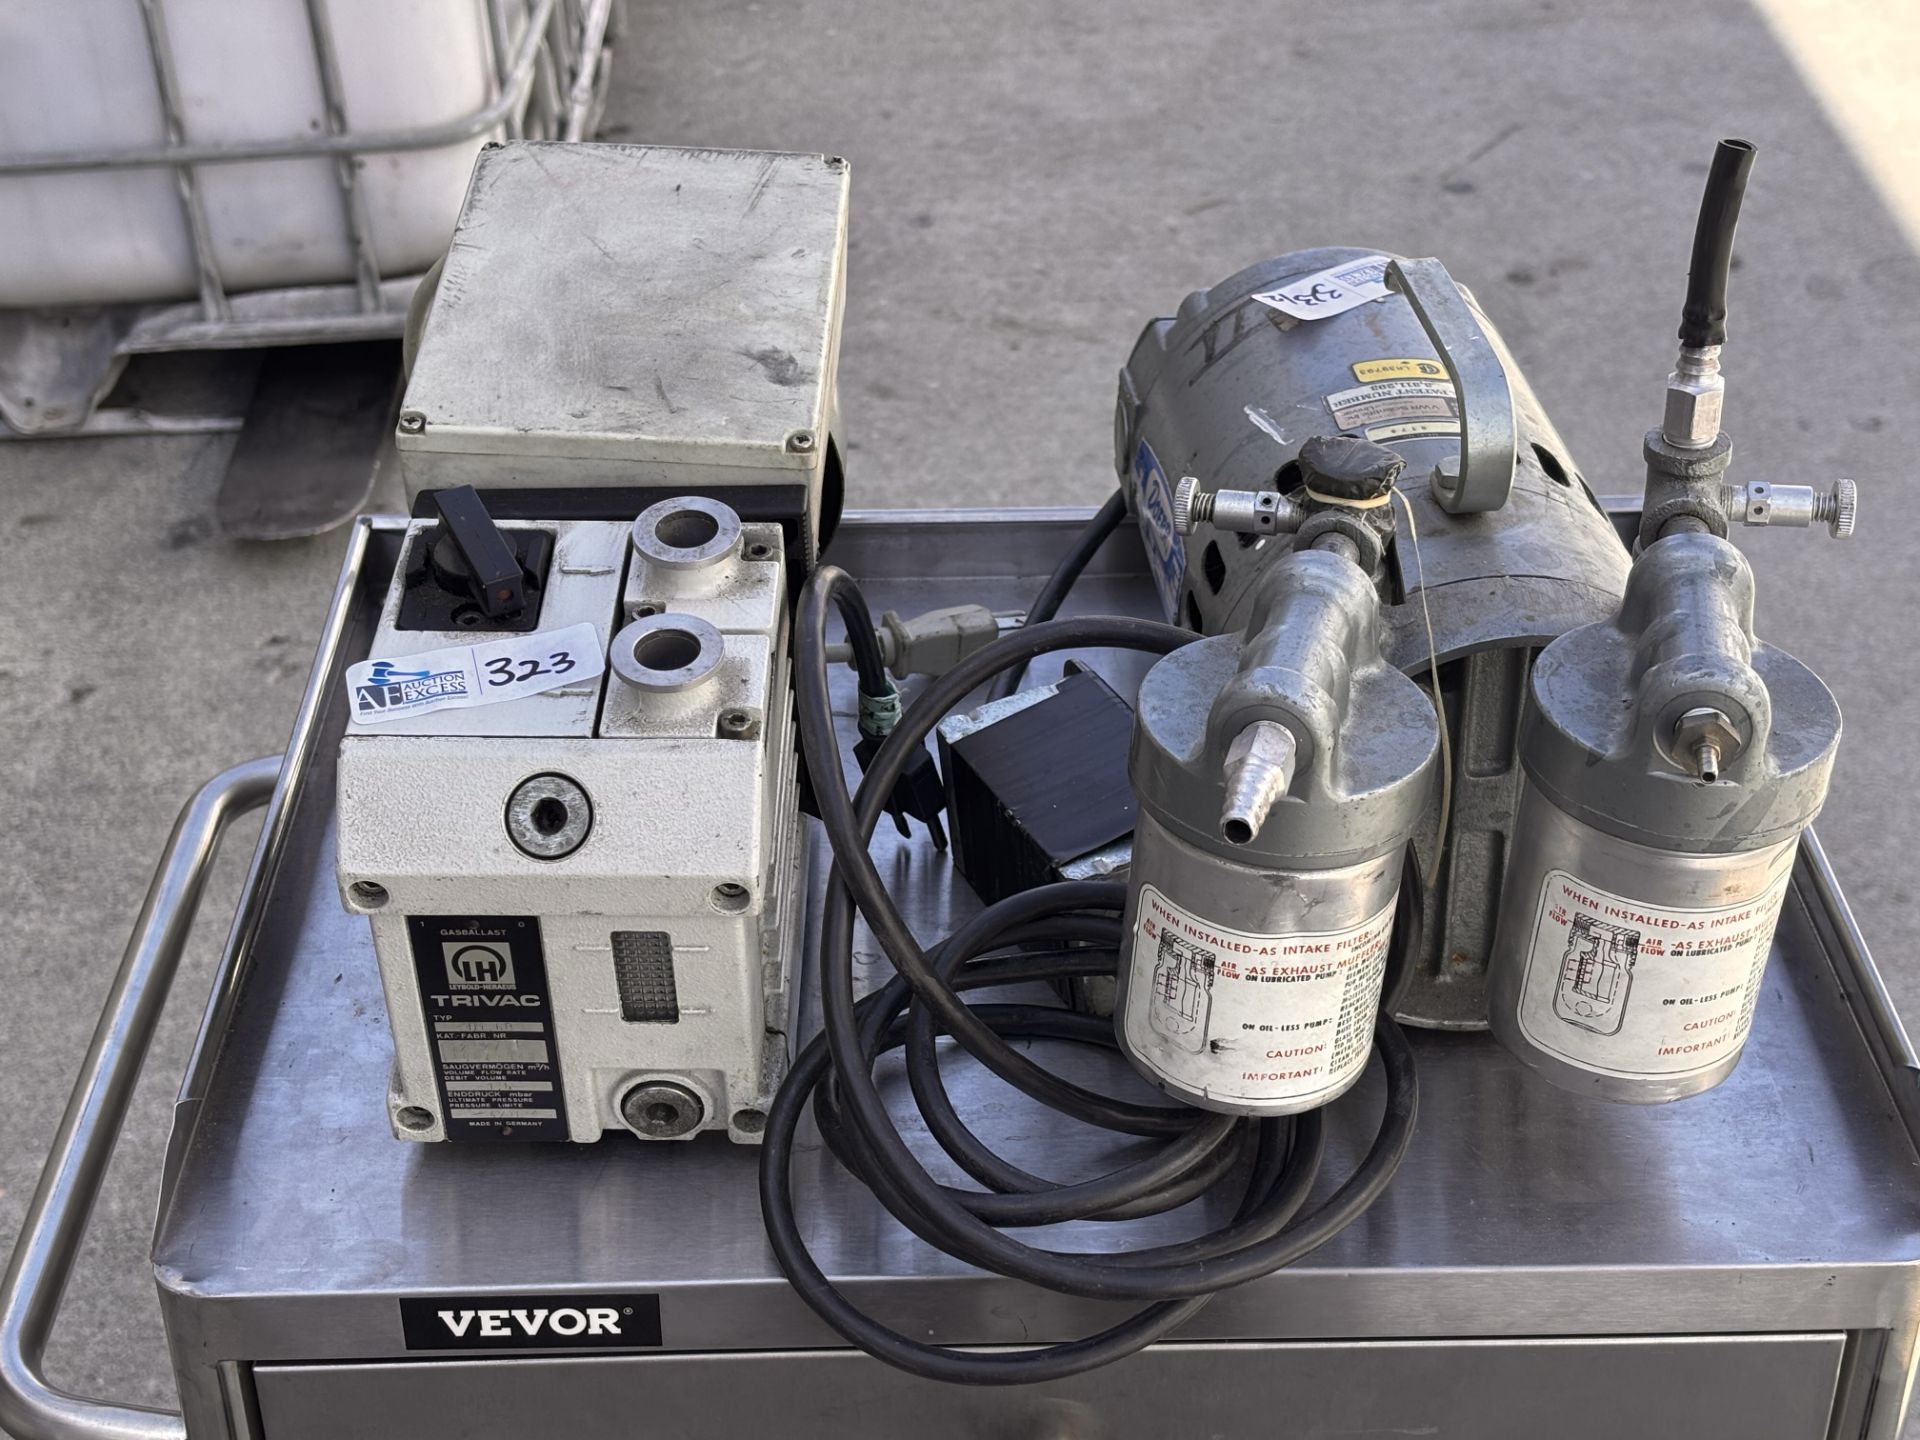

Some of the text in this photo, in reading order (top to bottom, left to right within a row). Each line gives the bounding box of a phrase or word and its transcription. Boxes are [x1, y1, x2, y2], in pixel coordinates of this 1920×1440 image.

[1332, 391, 1392, 408] NUMBER
[484, 652, 576, 687] 323
[403, 673, 465, 691] AUCTION
[404, 682, 467, 701] EXCESS
[1562, 884, 1600, 910] WHEN
[1710, 910, 1752, 929] INTAKE
[1151, 898, 1180, 928] WHEN
[1283, 943, 1332, 956] INTAKE
[1549, 910, 1568, 927] FLOW
[440, 928, 508, 937] GASBALLAST
[1698, 929, 1751, 949] EXHAUST
[1646, 938, 1663, 946] AIR
[1670, 949, 1683, 957] ON
[1686, 943, 1732, 957] LUBRICATED
[1641, 946, 1666, 957] FLOW
[462, 961, 499, 981] LH
[1220, 960, 1237, 970] AIR
[1272, 962, 1332, 976] EXHAUST
[1217, 969, 1240, 980] FLOW
[1245, 974, 1258, 982] ON
[1260, 974, 1312, 983] LUBRICATED
[430, 994, 541, 1007] TRIVAC
[437, 1307, 622, 1338] VEVOR
